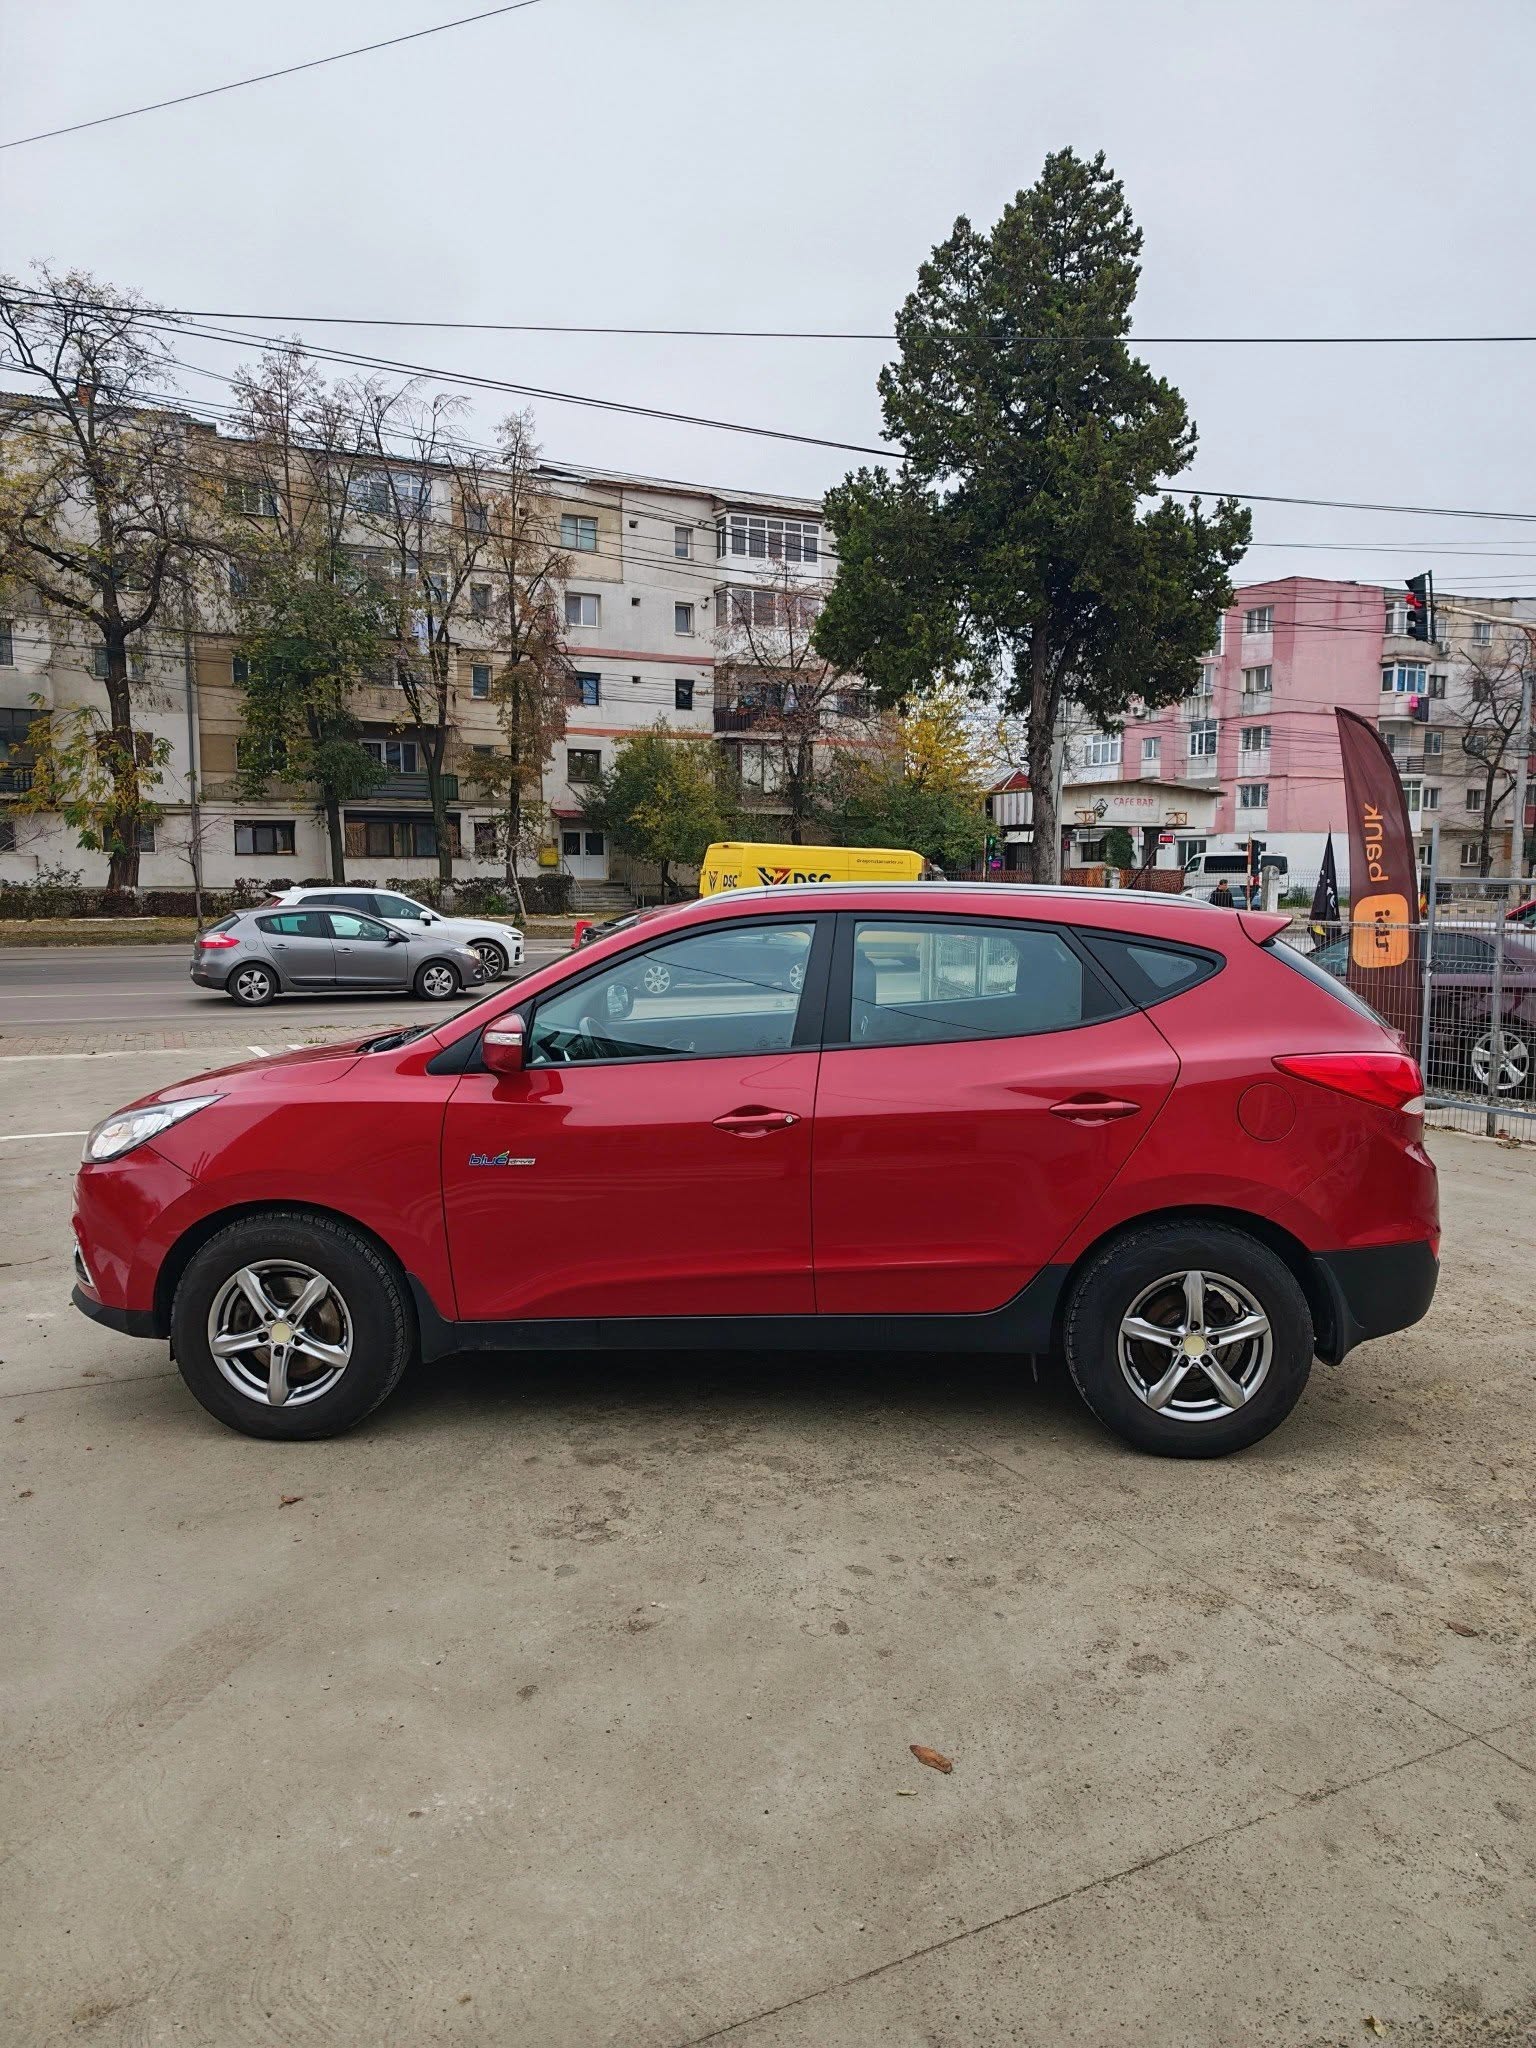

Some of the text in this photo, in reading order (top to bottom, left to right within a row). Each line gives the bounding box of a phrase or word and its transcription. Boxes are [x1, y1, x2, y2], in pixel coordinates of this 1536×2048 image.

[1114, 797, 1154, 807] CAFE BAR
[723, 875, 738, 887] DSC
[469, 1153, 508, 1166] blue
